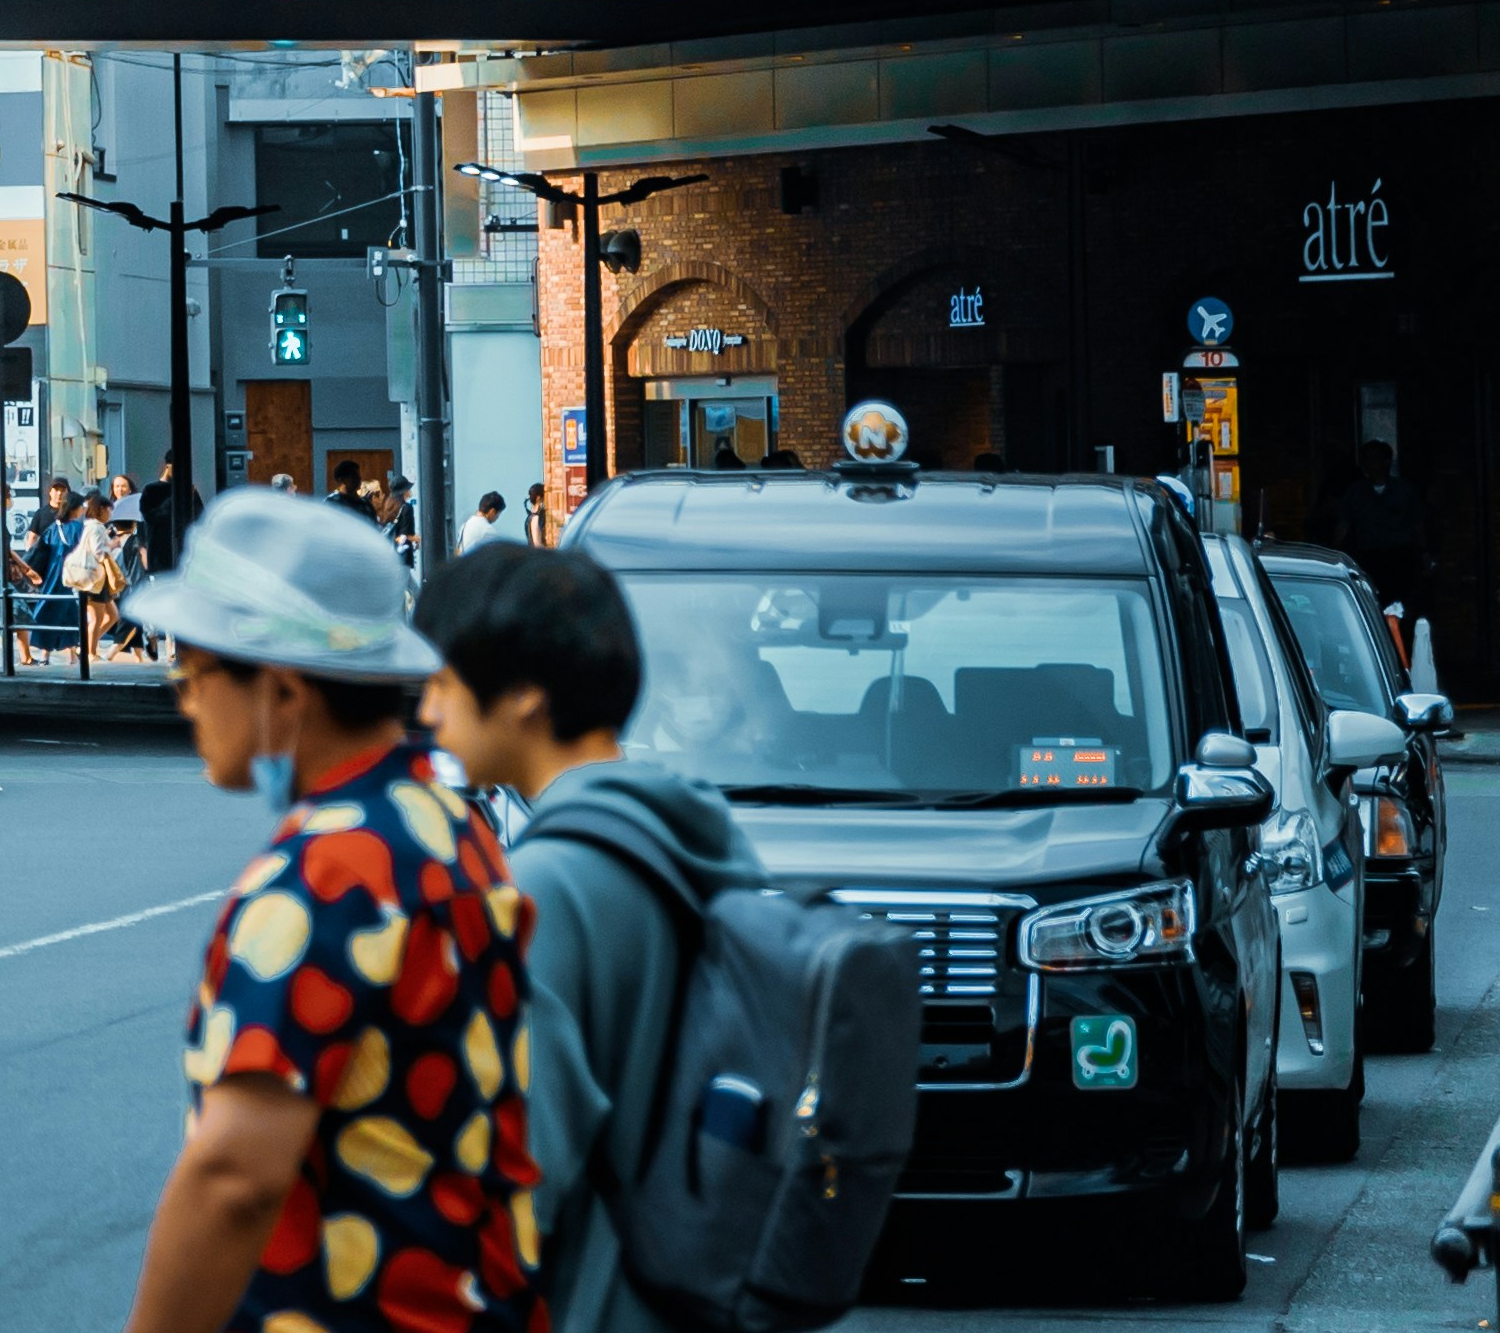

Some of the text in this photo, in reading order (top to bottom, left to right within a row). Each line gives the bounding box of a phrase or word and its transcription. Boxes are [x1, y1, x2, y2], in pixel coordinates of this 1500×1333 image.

[1304, 177, 1389, 271] atré
[950, 286, 984, 323] atré
[689, 329, 721, 355] DONQ
[1201, 351, 1223, 367] 10
